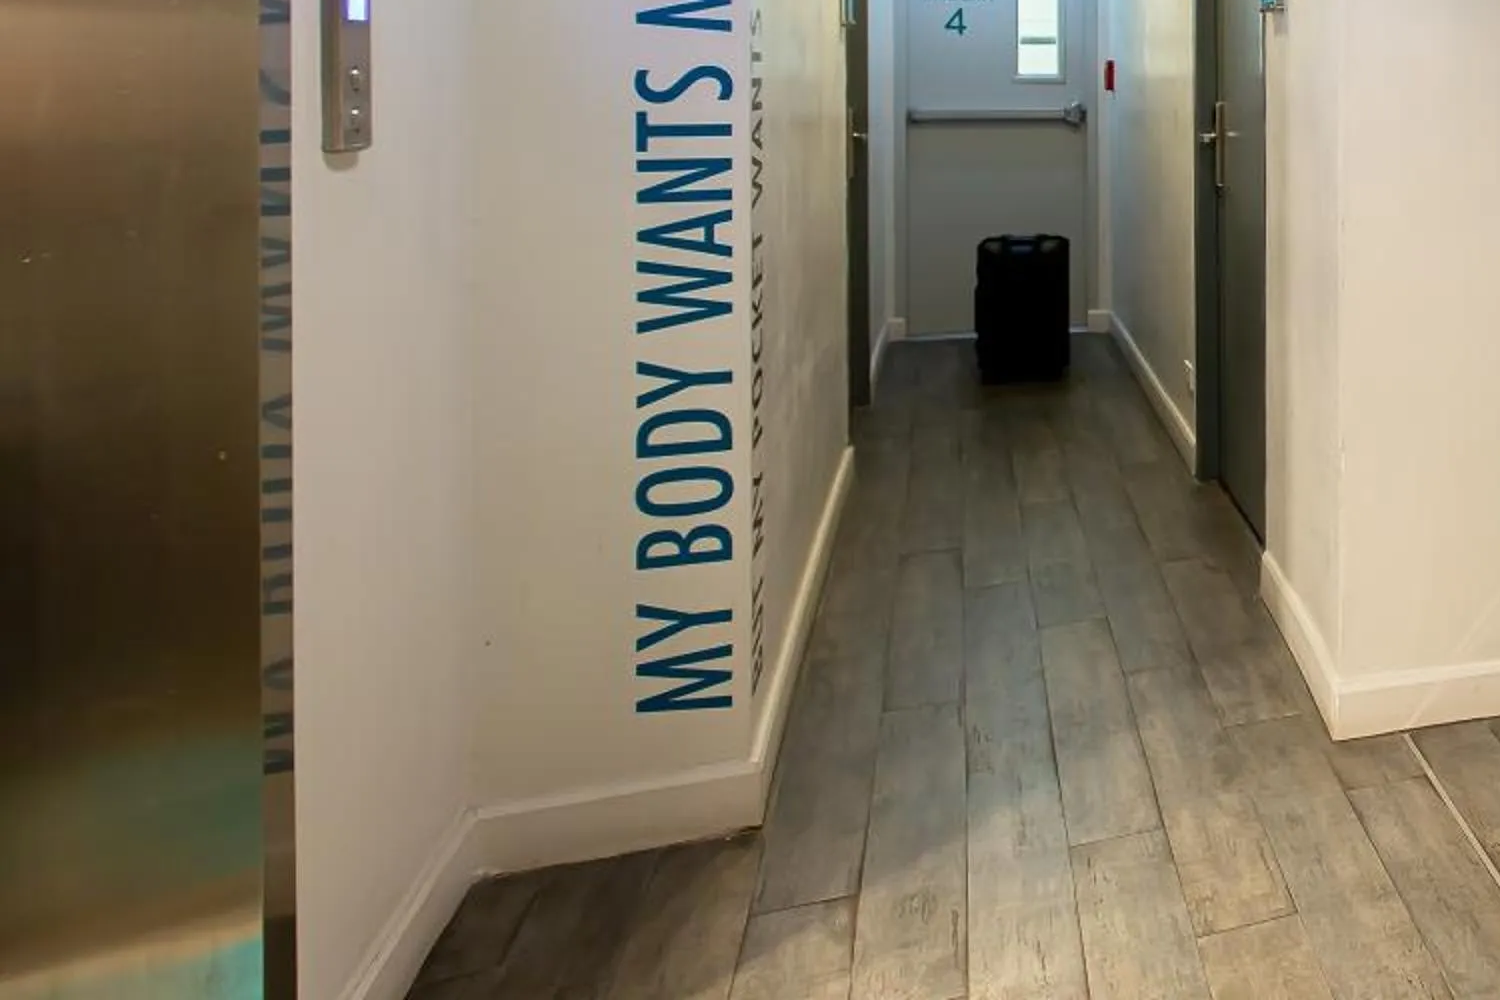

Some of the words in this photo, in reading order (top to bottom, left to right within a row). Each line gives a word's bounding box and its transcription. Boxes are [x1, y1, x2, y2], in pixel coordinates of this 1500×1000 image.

[749, 7, 764, 211] WANTS
[943, 7, 968, 36] 4
[634, 64, 733, 334] WANTS
[750, 231, 765, 451] POCKET
[635, 361, 734, 571] BODY
[635, 603, 733, 713] MY
